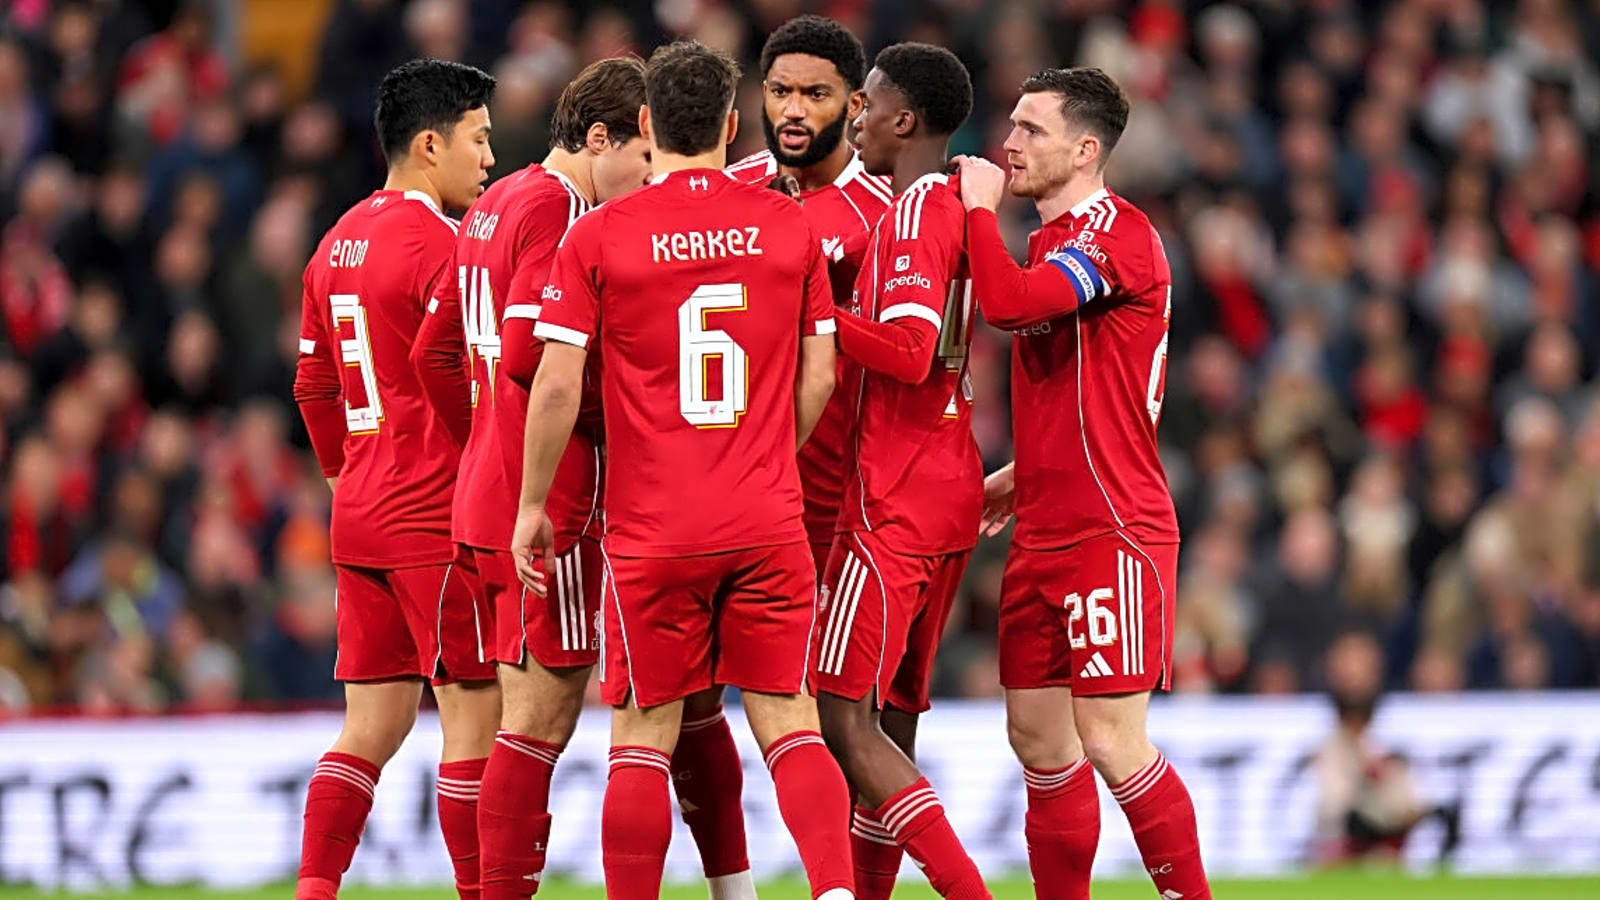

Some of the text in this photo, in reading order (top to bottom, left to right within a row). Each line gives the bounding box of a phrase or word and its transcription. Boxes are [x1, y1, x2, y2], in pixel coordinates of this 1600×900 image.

[329, 239, 369, 267] ENDO
[651, 227, 763, 263] KERKEZ
[329, 294, 385, 436] 3
[678, 283, 747, 429] 6
[1063, 587, 1118, 649] 26
